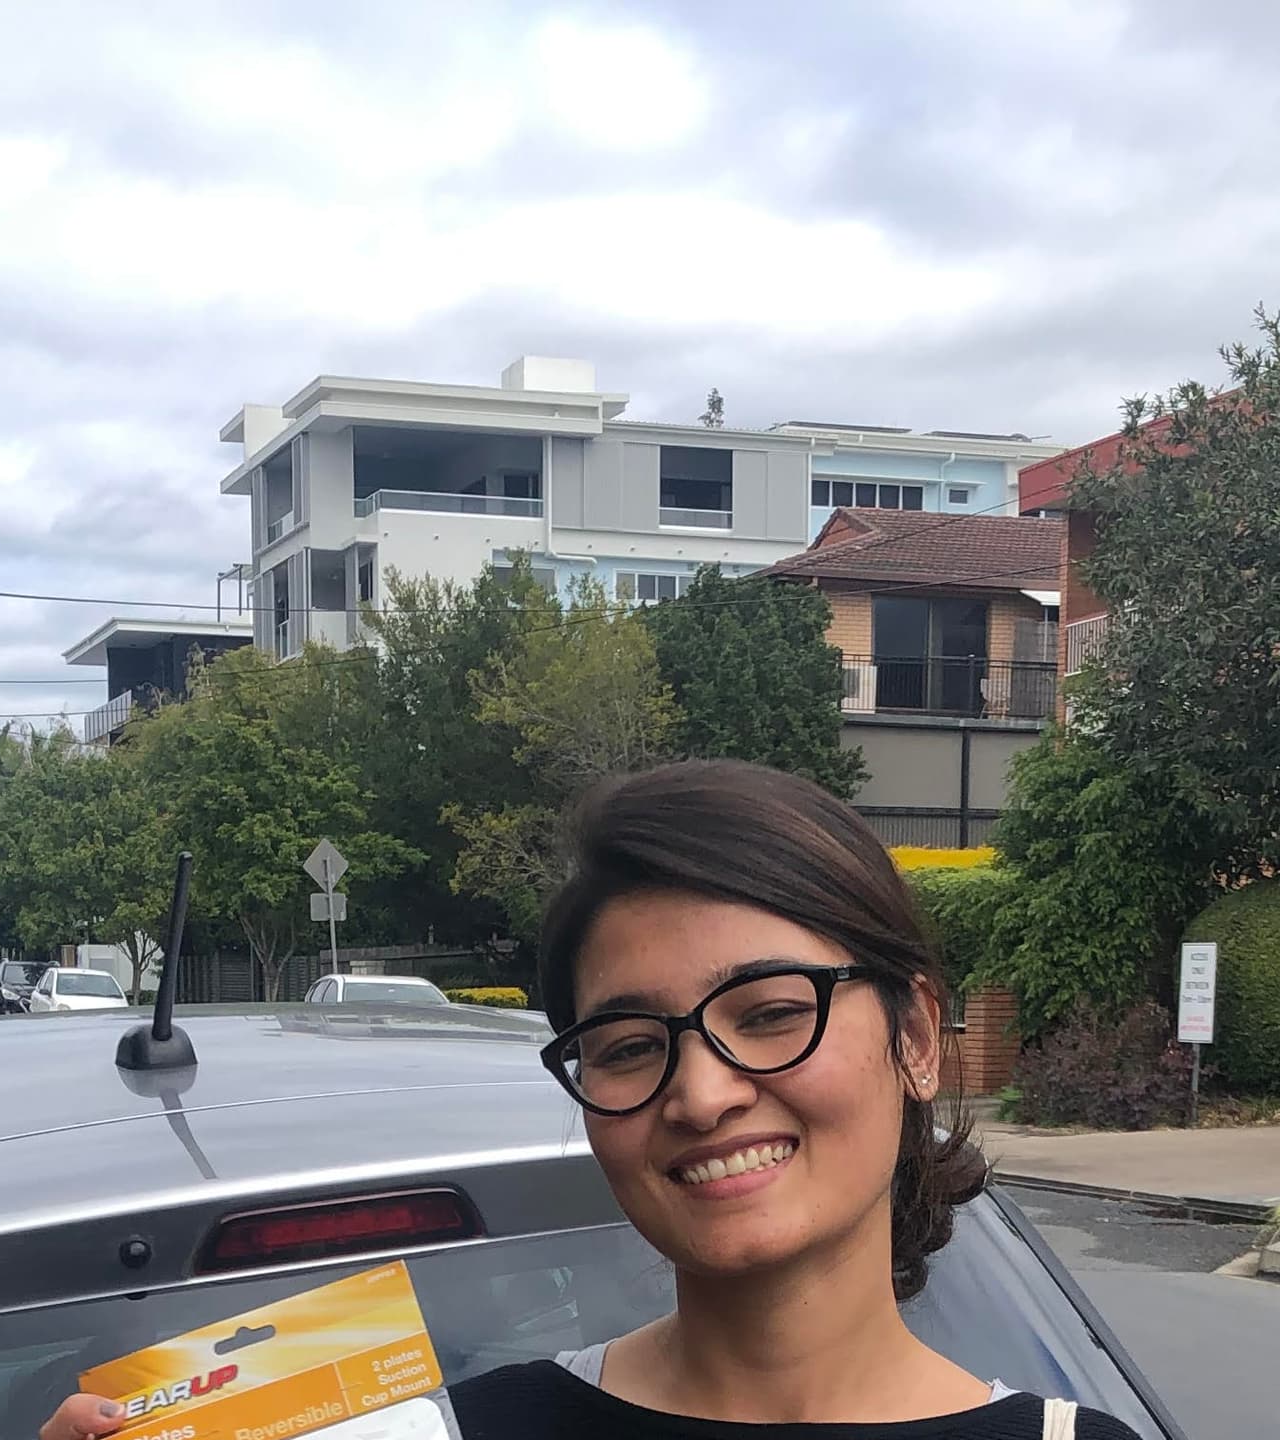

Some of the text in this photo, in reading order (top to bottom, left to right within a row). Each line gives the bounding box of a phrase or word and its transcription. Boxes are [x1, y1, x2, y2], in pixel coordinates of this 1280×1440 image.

[372, 1349, 423, 1372] 2 plates
[378, 1363, 427, 1385] Suction
[124, 1364, 238, 1420] EARUP
[362, 1376, 432, 1407] Cup Mount
